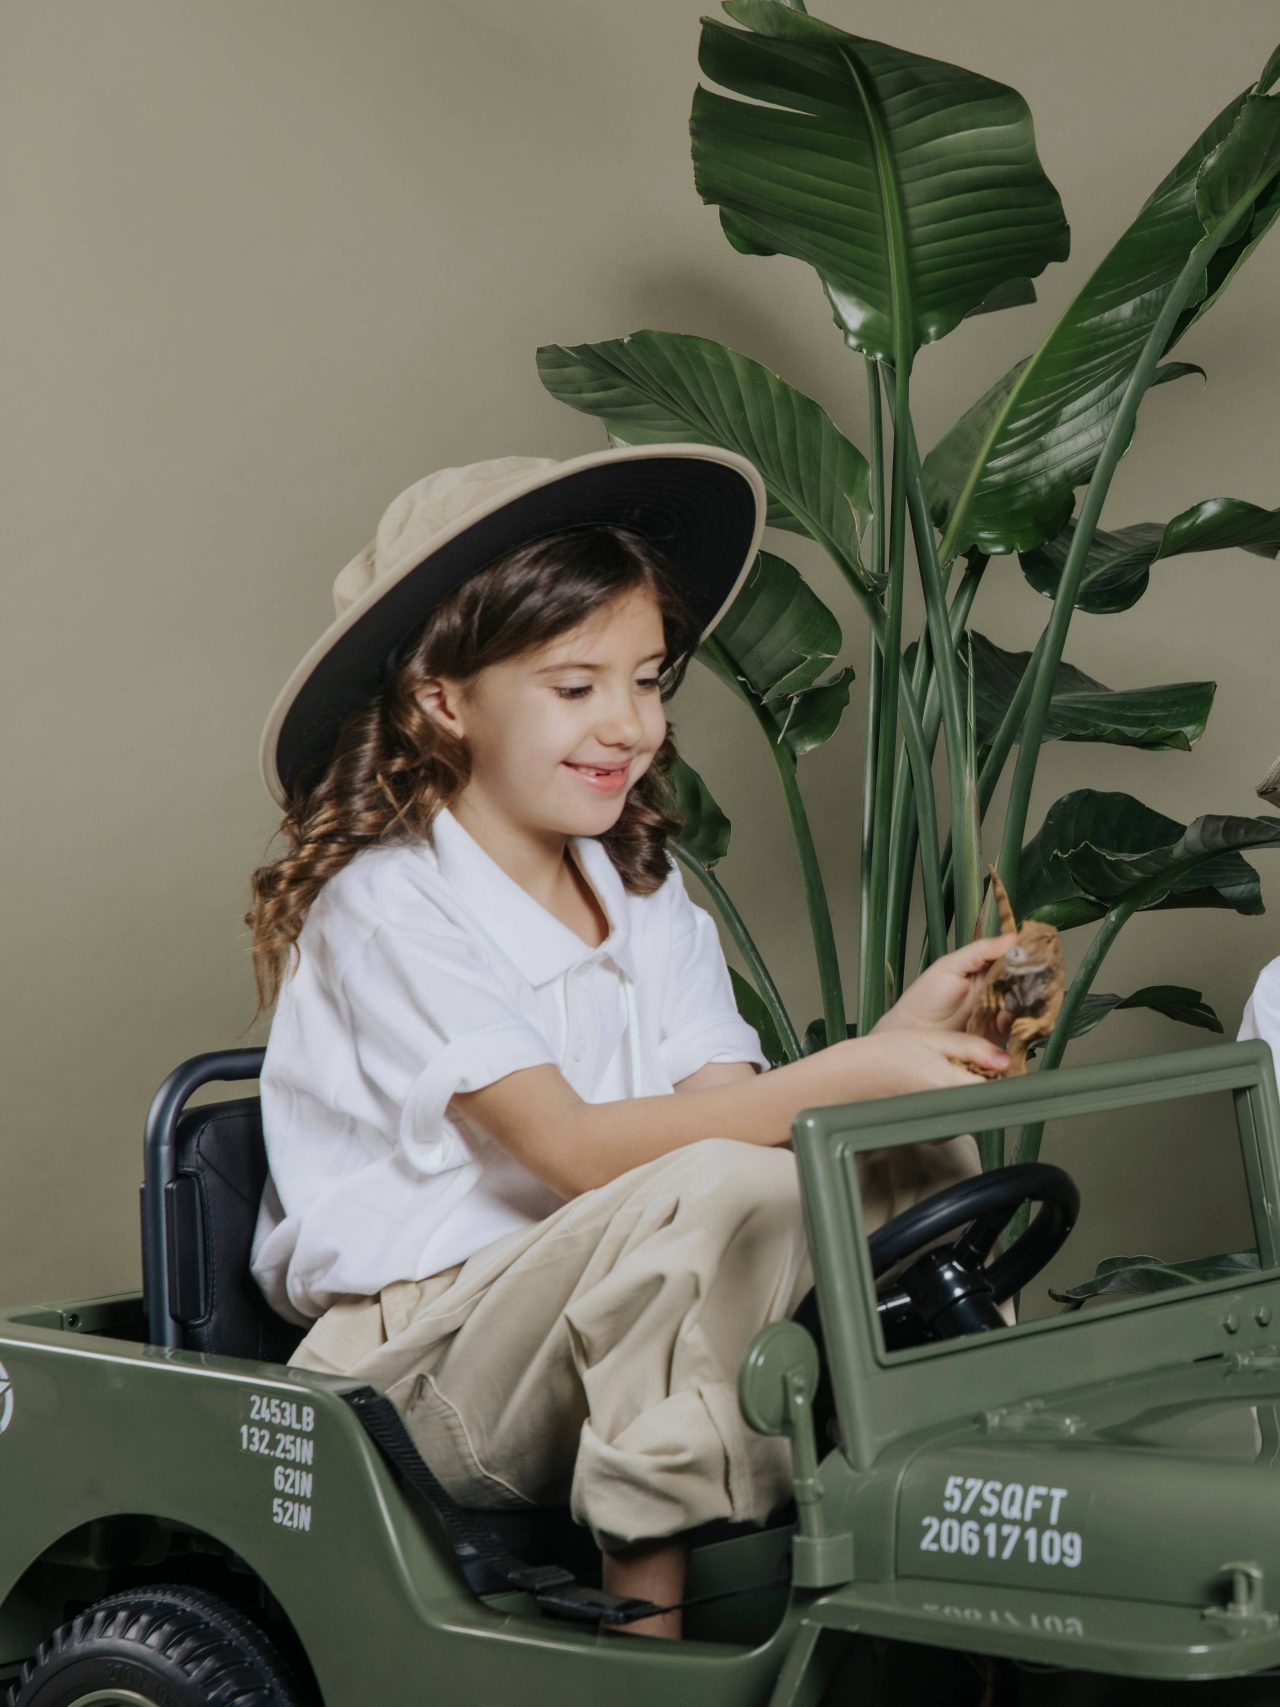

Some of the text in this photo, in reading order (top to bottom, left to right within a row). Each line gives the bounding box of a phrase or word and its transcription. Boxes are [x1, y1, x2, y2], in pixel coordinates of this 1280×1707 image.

[249, 1395, 315, 1432] 2453LB
[240, 1424, 313, 1466] 132.25IN
[273, 1465, 313, 1498] 62IN
[943, 1475, 1068, 1525] 57SQFT
[272, 1497, 312, 1531] 52IN
[919, 1516, 1082, 1568] 20617109
